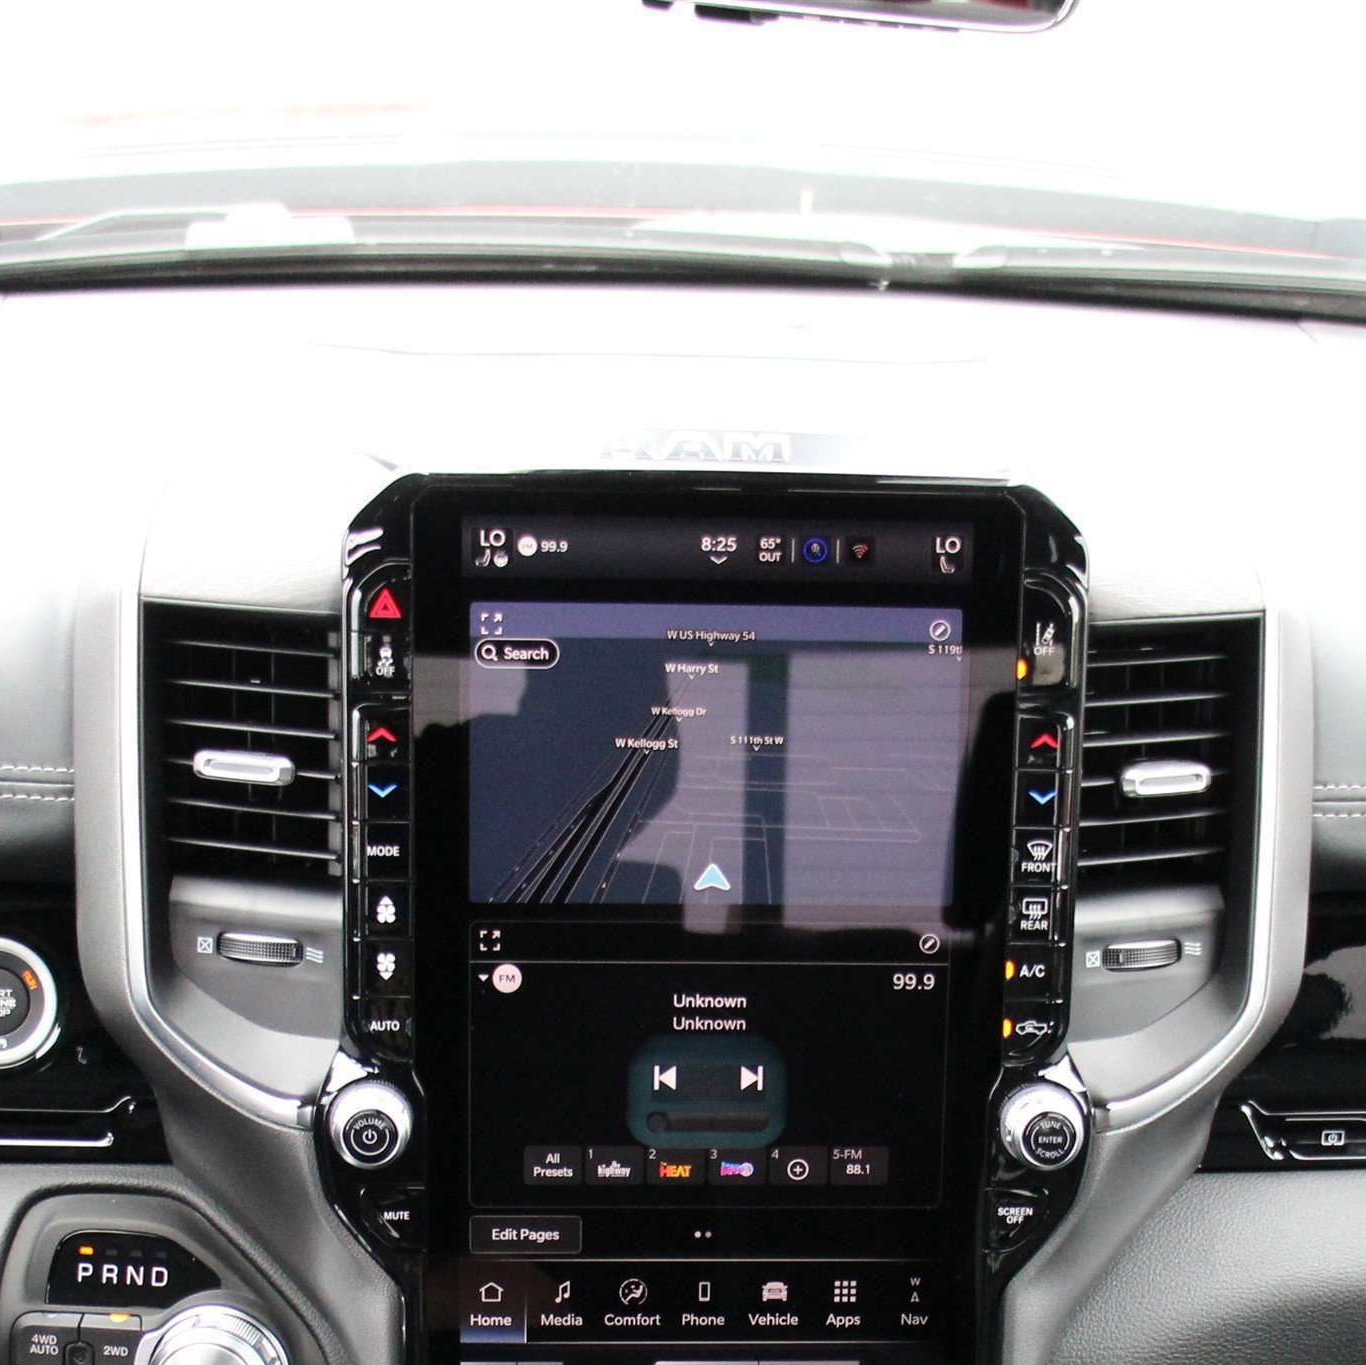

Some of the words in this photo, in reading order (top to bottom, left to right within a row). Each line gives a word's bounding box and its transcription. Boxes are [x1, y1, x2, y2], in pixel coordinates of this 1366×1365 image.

[479, 529, 506, 547] LO
[541, 541, 568, 553] 99.9
[701, 537, 737, 552] 8:25
[935, 537, 961, 554] LO
[759, 552, 782, 562] OUT
[666, 630, 677, 639] W
[679, 630, 694, 640] US
[695, 630, 740, 643] Highway
[742, 631, 756, 641] 54
[503, 646, 550, 661] Search
[1033, 647, 1055, 656] OFF
[376, 666, 395, 676] OFF
[665, 664, 676, 673] W
[678, 664, 706, 676] Harry
[708, 664, 719, 674] St
[651, 707, 661, 715] W
[661, 707, 694, 717] Kellogg
[696, 708, 707, 716] Dr
[615, 739, 626, 748] W
[627, 739, 666, 750] Kellogg
[668, 739, 678, 749] St
[764, 736, 773, 745] St
[774, 736, 784, 745] W
[366, 846, 400, 857] MODE
[1021, 861, 1057, 873] FRONT
[1020, 919, 1048, 931] REAR
[1019, 964, 1046, 978] A/C
[22, 970, 37, 990] RUN
[497, 973, 516, 985] FM
[892, 974, 935, 991] 99.9
[673, 994, 747, 1010] Unknown
[370, 1020, 400, 1032] AUTO
[673, 1016, 746, 1032] Unknown
[352, 1117, 386, 1131] VOLUME
[1040, 1120, 1062, 1130] TUNE
[1038, 1135, 1063, 1144] ENTER
[545, 1153, 561, 1164] All
[649, 1149, 657, 1160] 2
[710, 1149, 718, 1160] 3
[771, 1149, 779, 1160] 4
[833, 1149, 863, 1160] 5-FM
[1035, 1147, 1065, 1159] SCROLL
[533, 1167, 574, 1178] Presets
[659, 1164, 692, 1178] HEAT
[846, 1164, 870, 1175] 88.1
[384, 1211, 410, 1221] MUTE
[997, 1207, 1034, 1217] SCREEN
[1006, 1216, 1025, 1225] OFF
[492, 1228, 518, 1240] Edit
[520, 1228, 560, 1243] Pages
[470, 1313, 512, 1326] Home
[540, 1313, 583, 1326] Media
[604, 1313, 661, 1326] Comfort
[682, 1313, 725, 1326] Phone
[748, 1313, 799, 1326] Vehicle
[825, 1313, 861, 1328] Apps
[900, 1314, 928, 1326] Nav
[31, 1334, 57, 1345] 4WD
[30, 1344, 59, 1356] AUTO
[103, 1346, 129, 1357] 2WD
